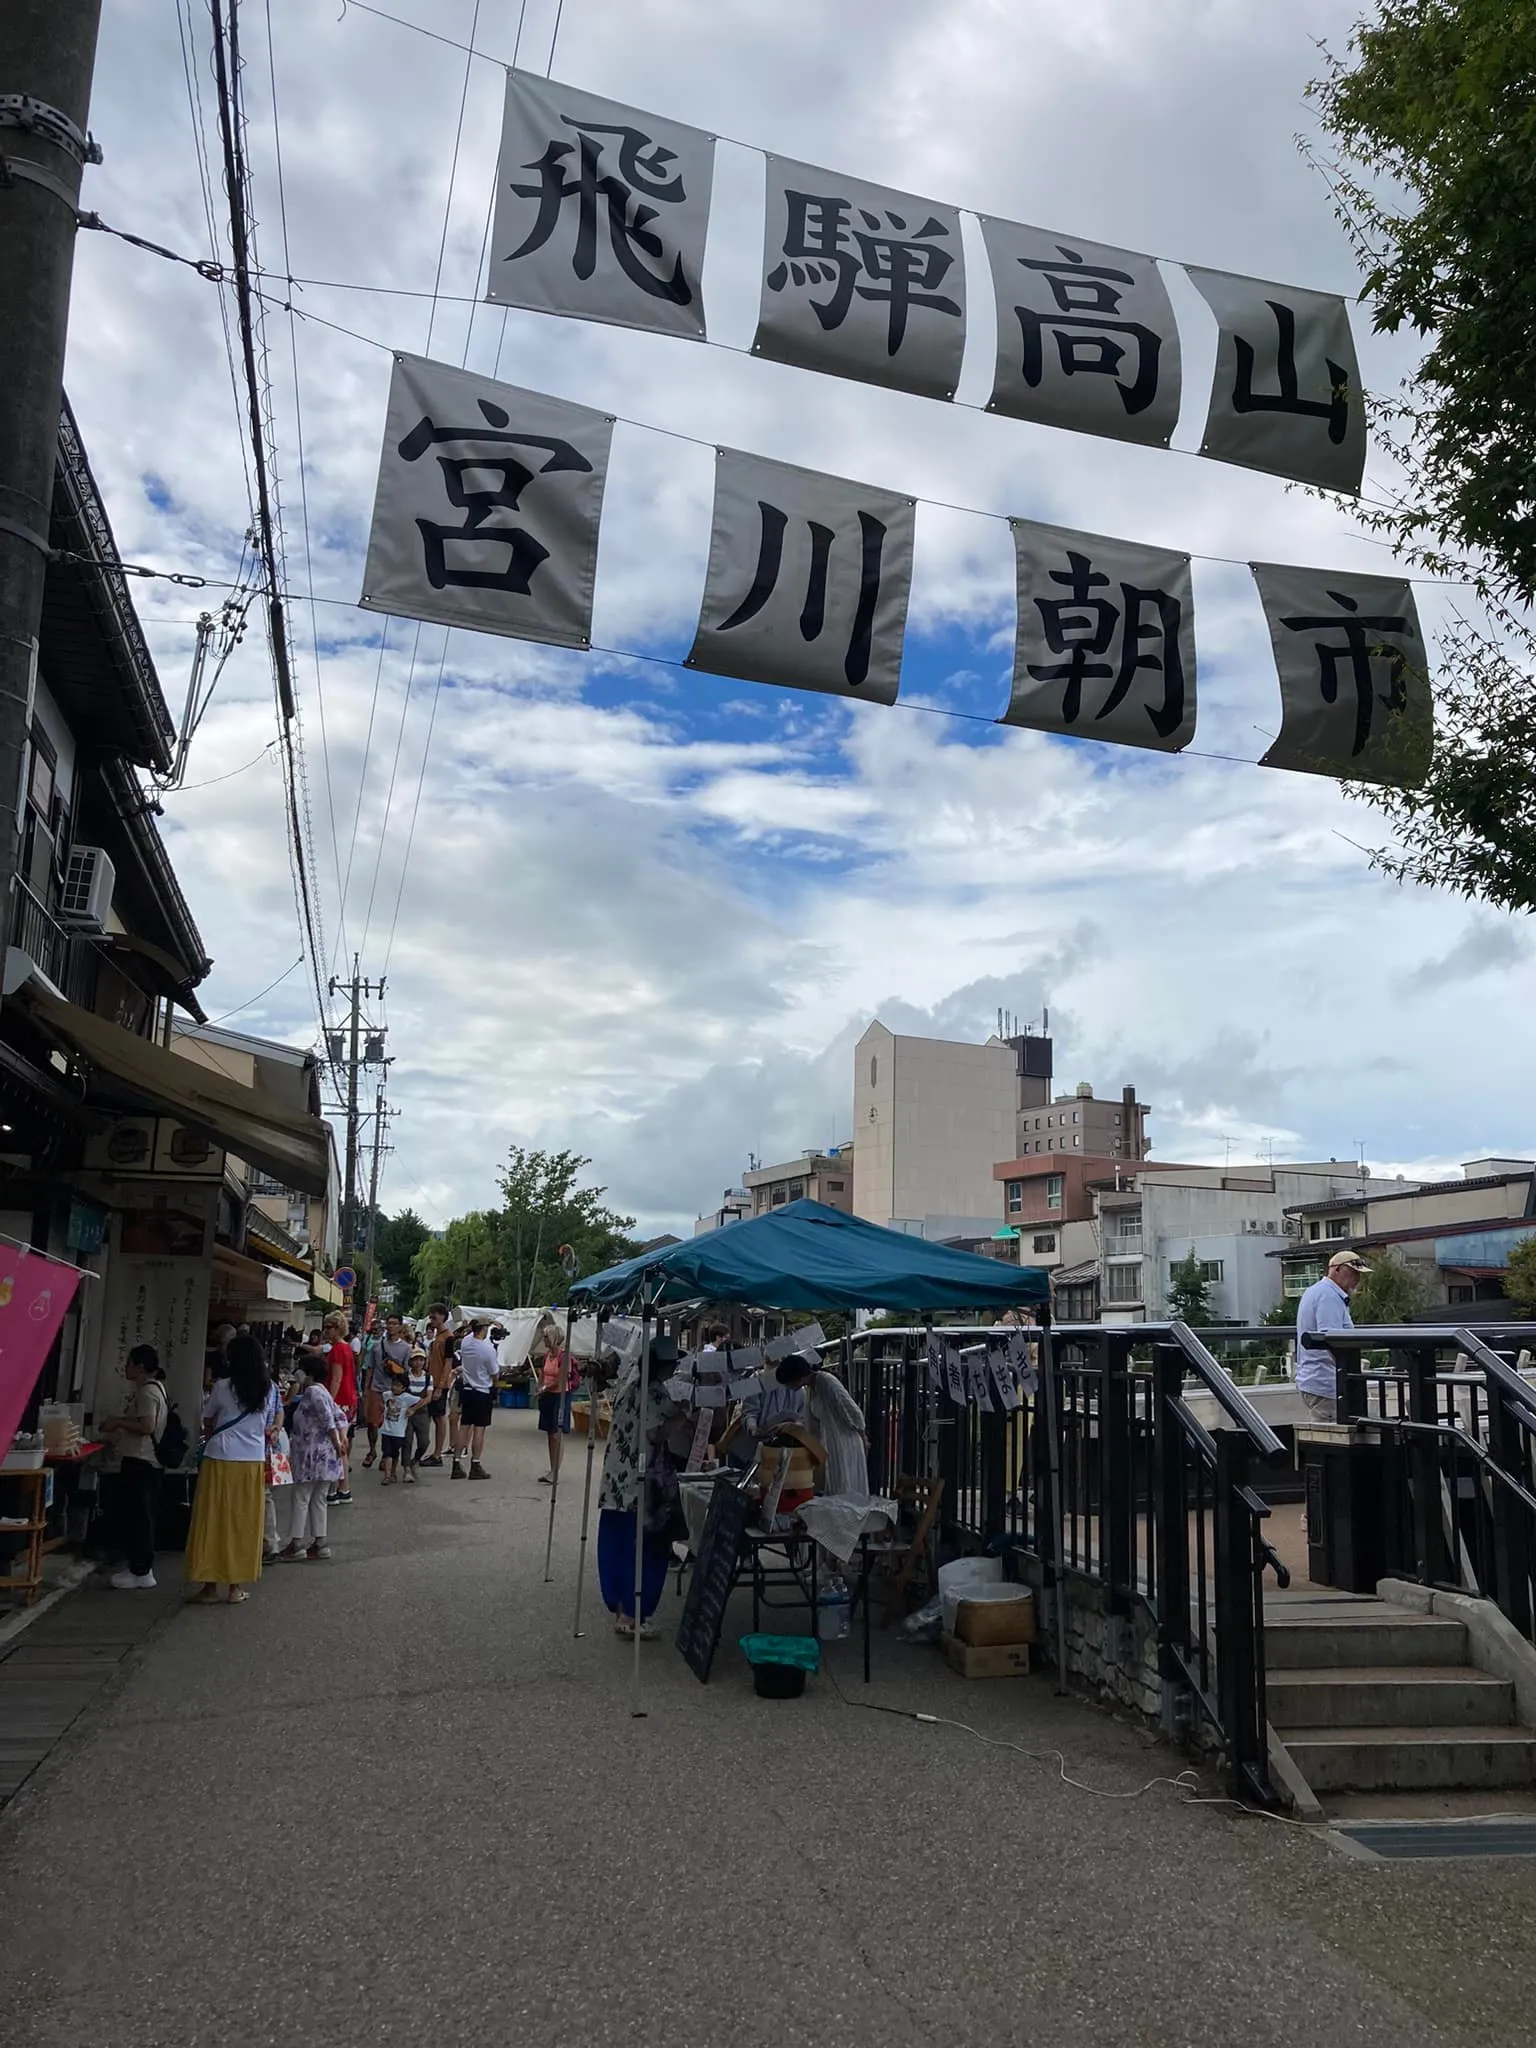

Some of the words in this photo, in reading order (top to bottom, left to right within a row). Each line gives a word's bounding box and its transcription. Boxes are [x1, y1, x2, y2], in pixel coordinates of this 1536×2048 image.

[503, 114, 1349, 445] 飛騨高山
[398, 398, 1414, 757] 宮川朝市
